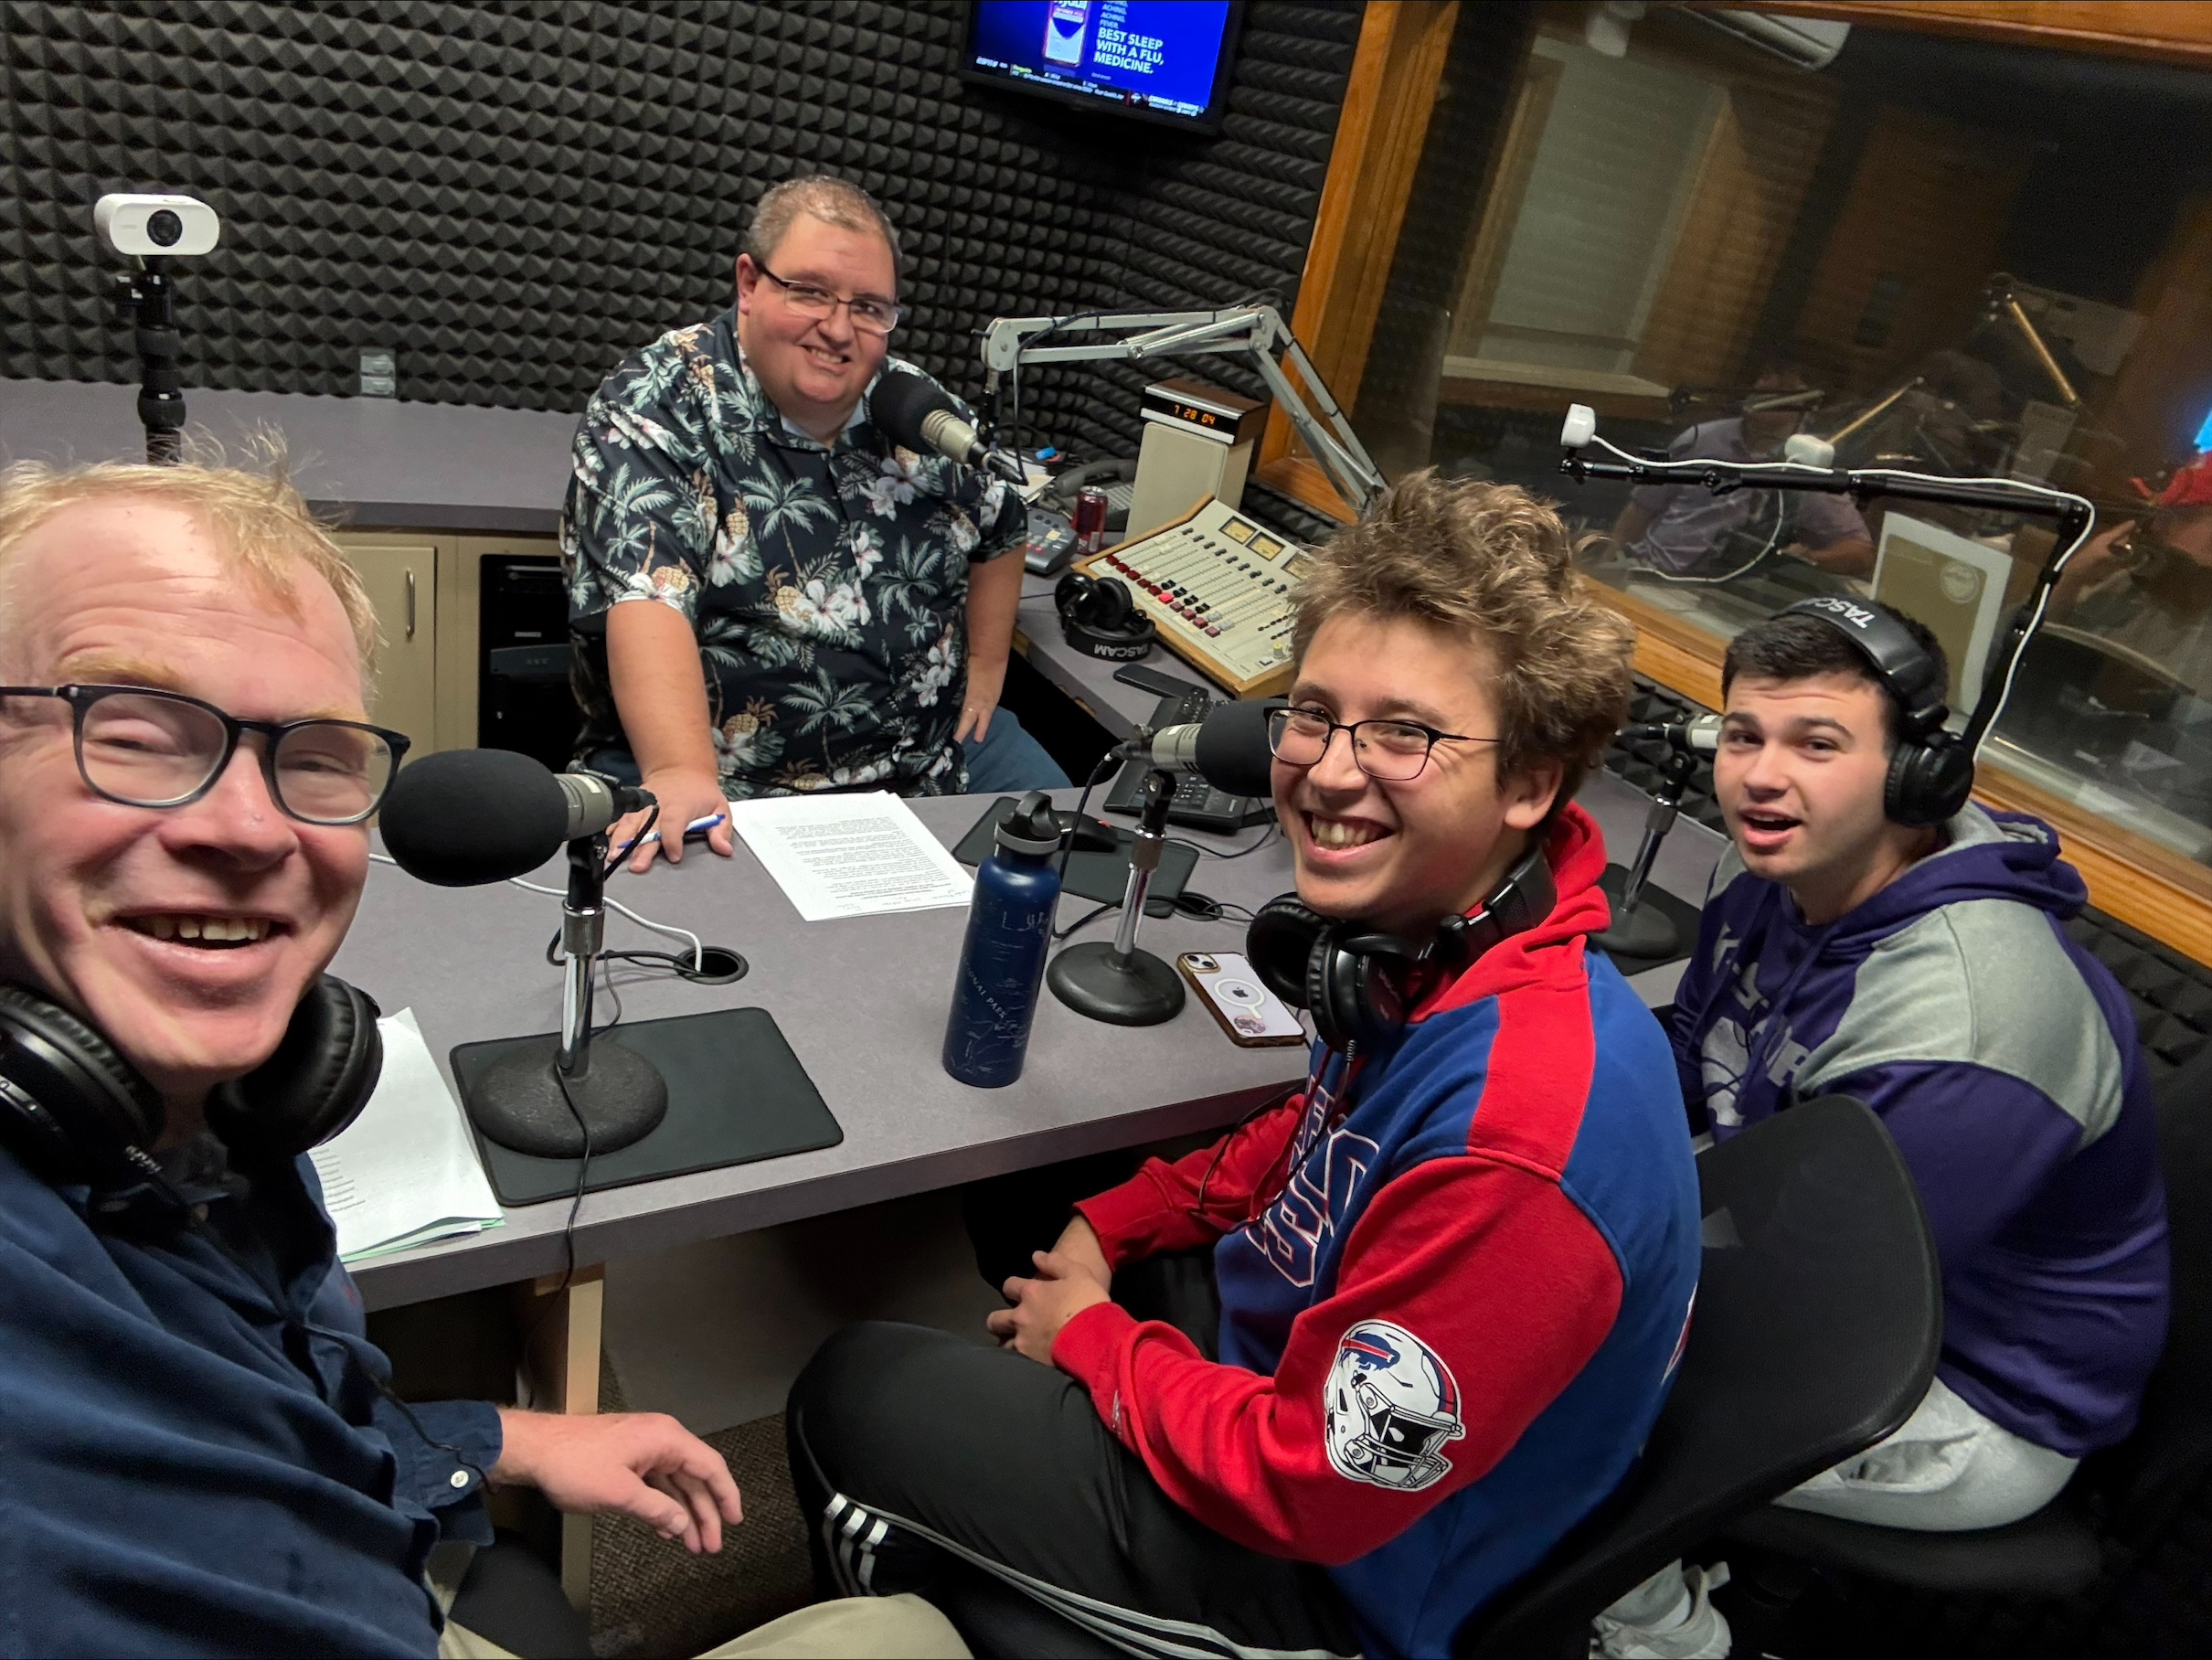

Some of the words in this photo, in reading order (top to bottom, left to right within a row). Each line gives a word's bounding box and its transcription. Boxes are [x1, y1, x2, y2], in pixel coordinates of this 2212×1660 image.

[1098, 27, 1128, 42] BEST
[1128, 34, 1164, 50] SLEEP
[1093, 51, 1154, 74] MEDICINE.
[1097, 39, 1127, 55] WITH
[1128, 47, 1138, 58] A
[1140, 48, 1164, 66] FLU,
[1183, 409, 1197, 420] 28
[1201, 413, 1216, 425] 04
